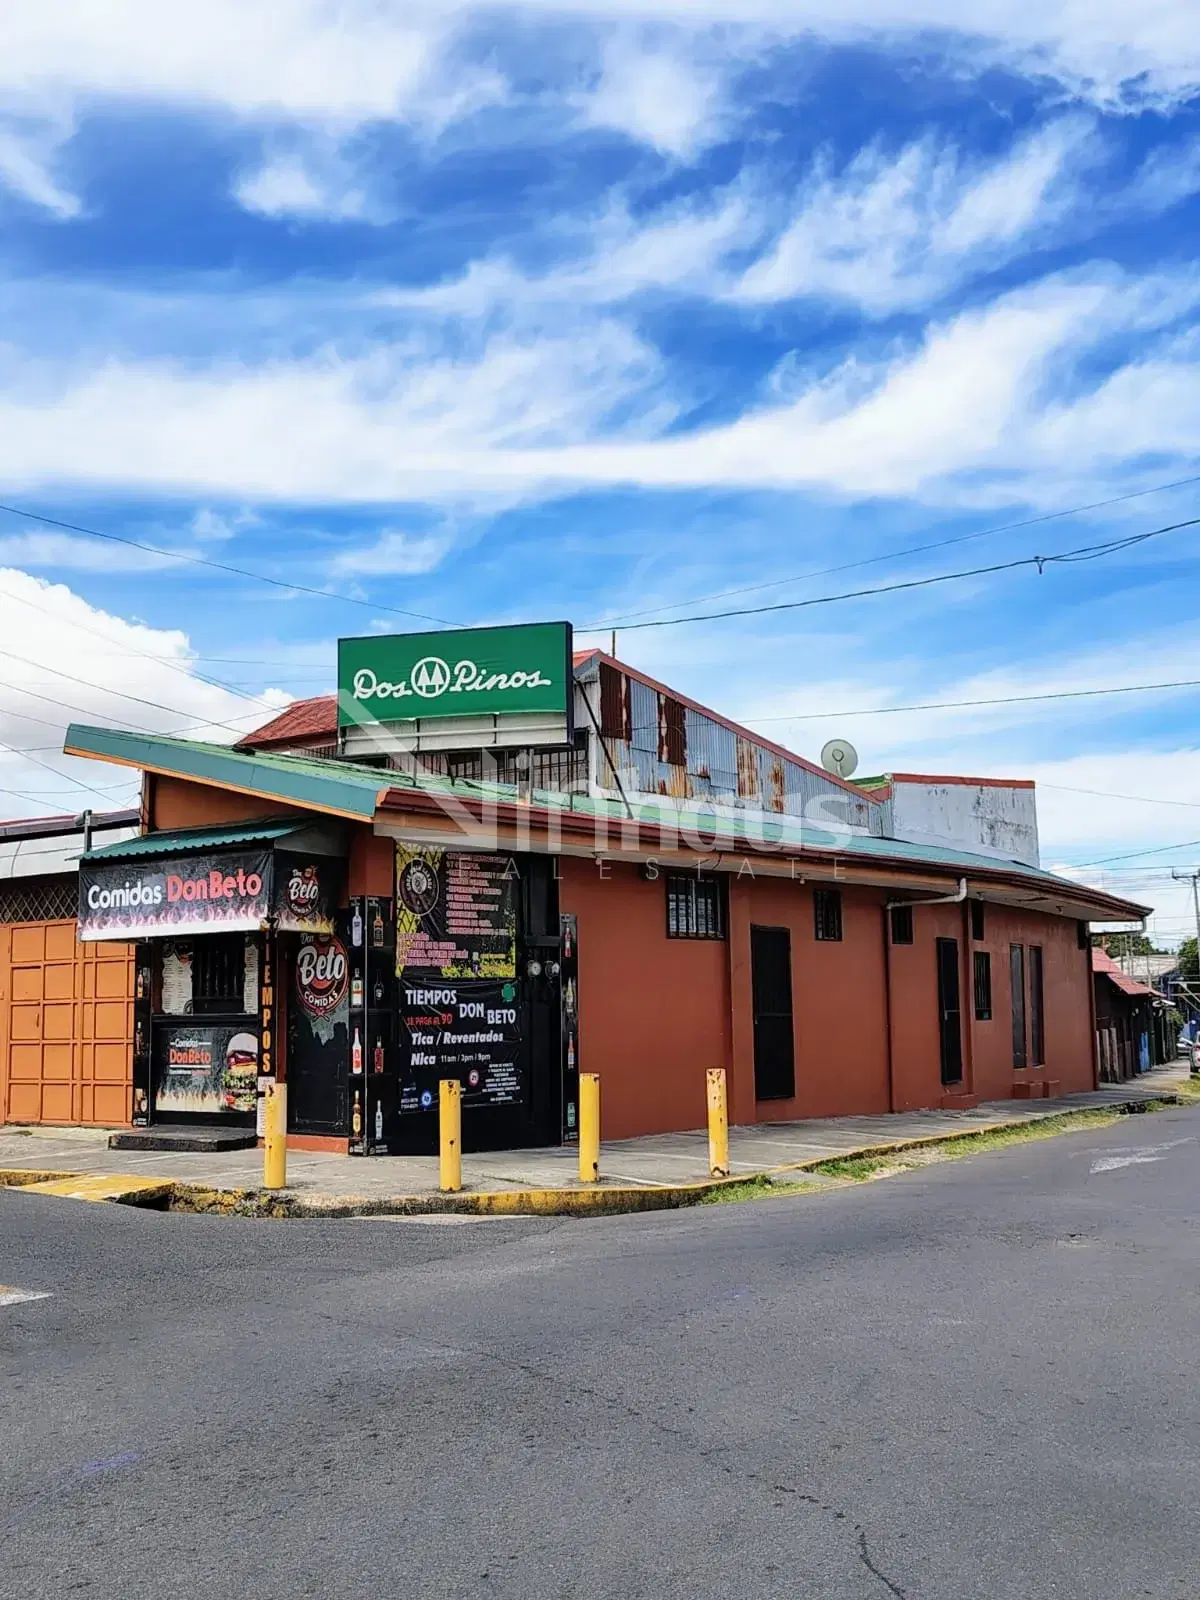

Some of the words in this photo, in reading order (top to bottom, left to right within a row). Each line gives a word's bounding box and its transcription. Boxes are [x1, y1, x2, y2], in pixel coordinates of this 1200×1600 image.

[353, 669, 413, 699] Dos
[450, 660, 552, 692] Pinos
[88, 880, 162, 910] Comidas
[297, 945, 345, 986] Beto
[304, 990, 339, 1007] COMIDAS
[405, 989, 457, 1005] TIEMPOS
[460, 1003, 485, 1018] DON
[487, 1009, 517, 1024] BETO
[441, 1013, 453, 1025] 90
[411, 1032, 434, 1045] Tica
[443, 1030, 504, 1044] Reventados
[410, 1052, 436, 1066] Nica
[441, 1054, 457, 1063] 11am
